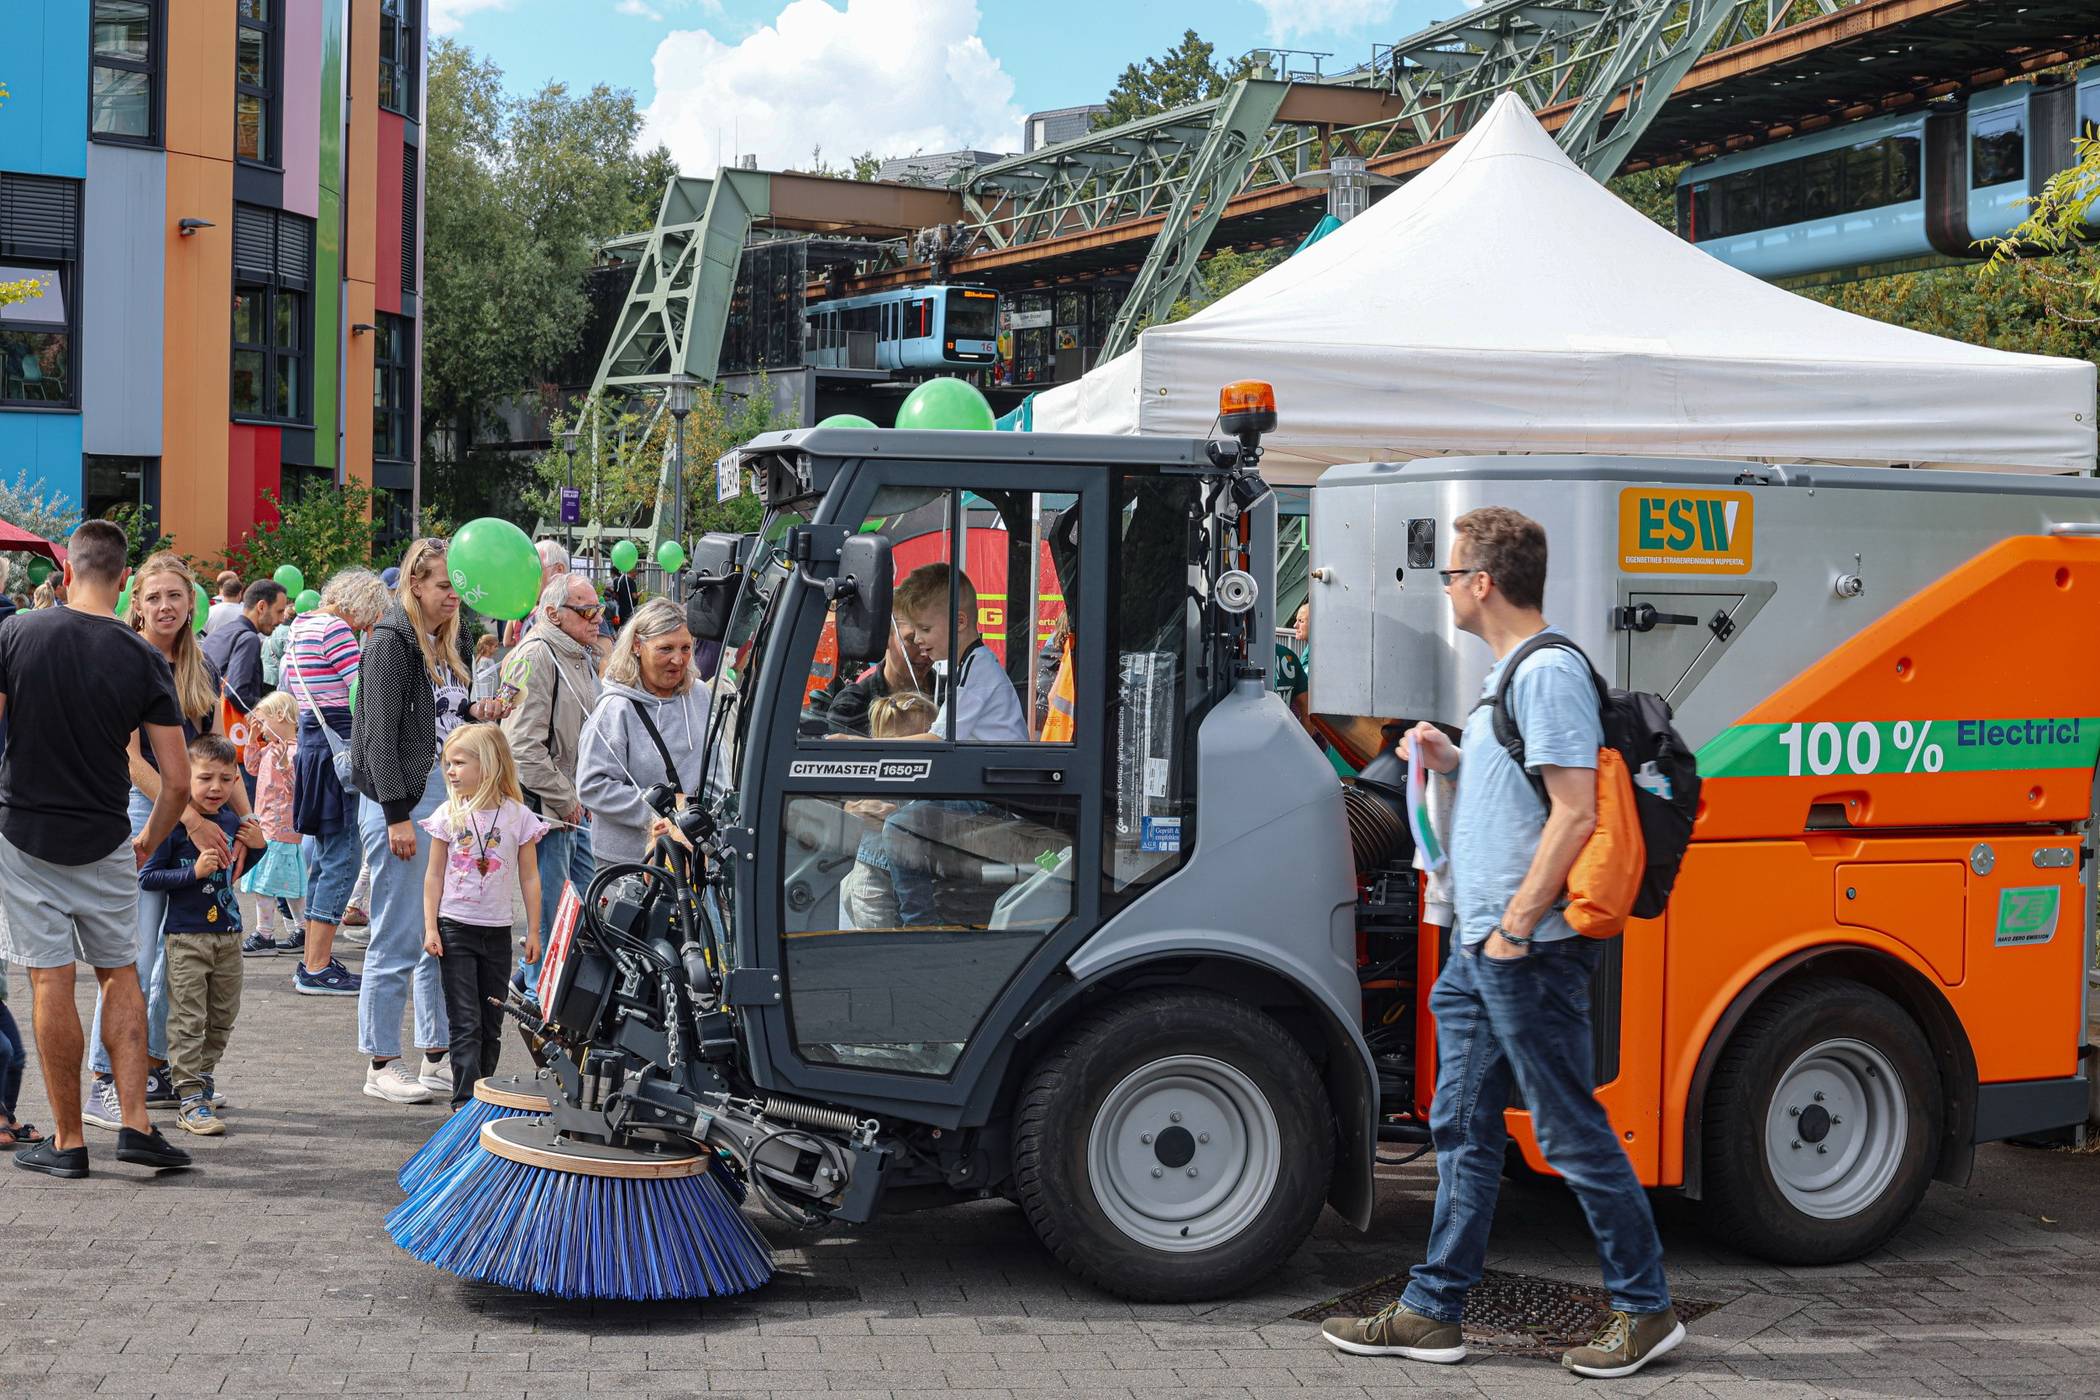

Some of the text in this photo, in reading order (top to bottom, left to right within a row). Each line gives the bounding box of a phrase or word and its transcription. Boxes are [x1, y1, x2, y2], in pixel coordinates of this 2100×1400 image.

[981, 342, 992, 352] 16
[1639, 498, 1739, 551] ESW
[1779, 718, 2080, 776] 100 % Electric!
[794, 764, 877, 774] CITYMASTER
